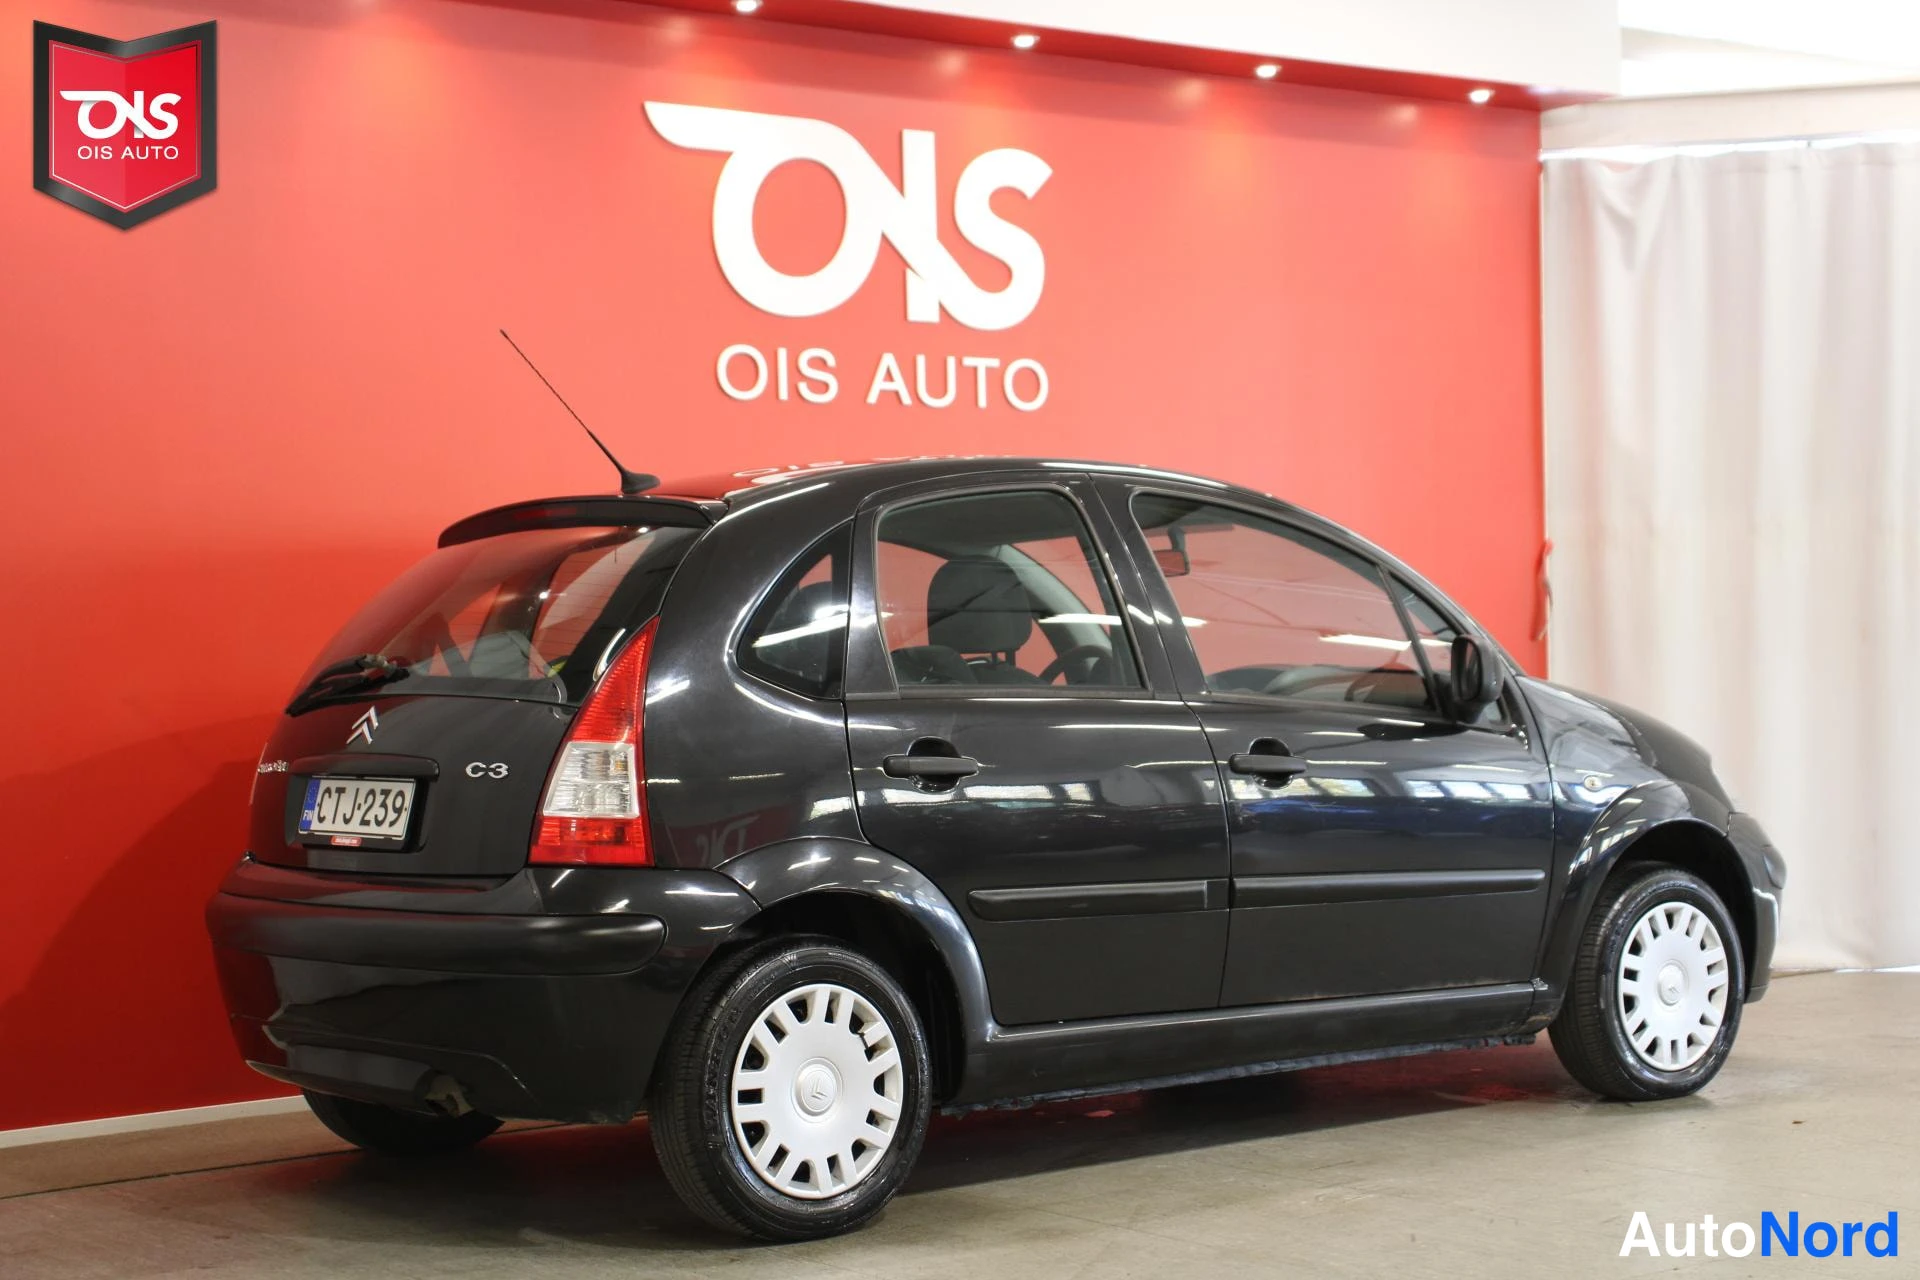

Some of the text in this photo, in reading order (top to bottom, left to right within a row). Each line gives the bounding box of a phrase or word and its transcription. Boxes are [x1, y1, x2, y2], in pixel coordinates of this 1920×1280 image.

[715, 343, 1049, 412] OIS AUTO
[465, 761, 509, 779] C3
[316, 785, 407, 828] CTJ-239
